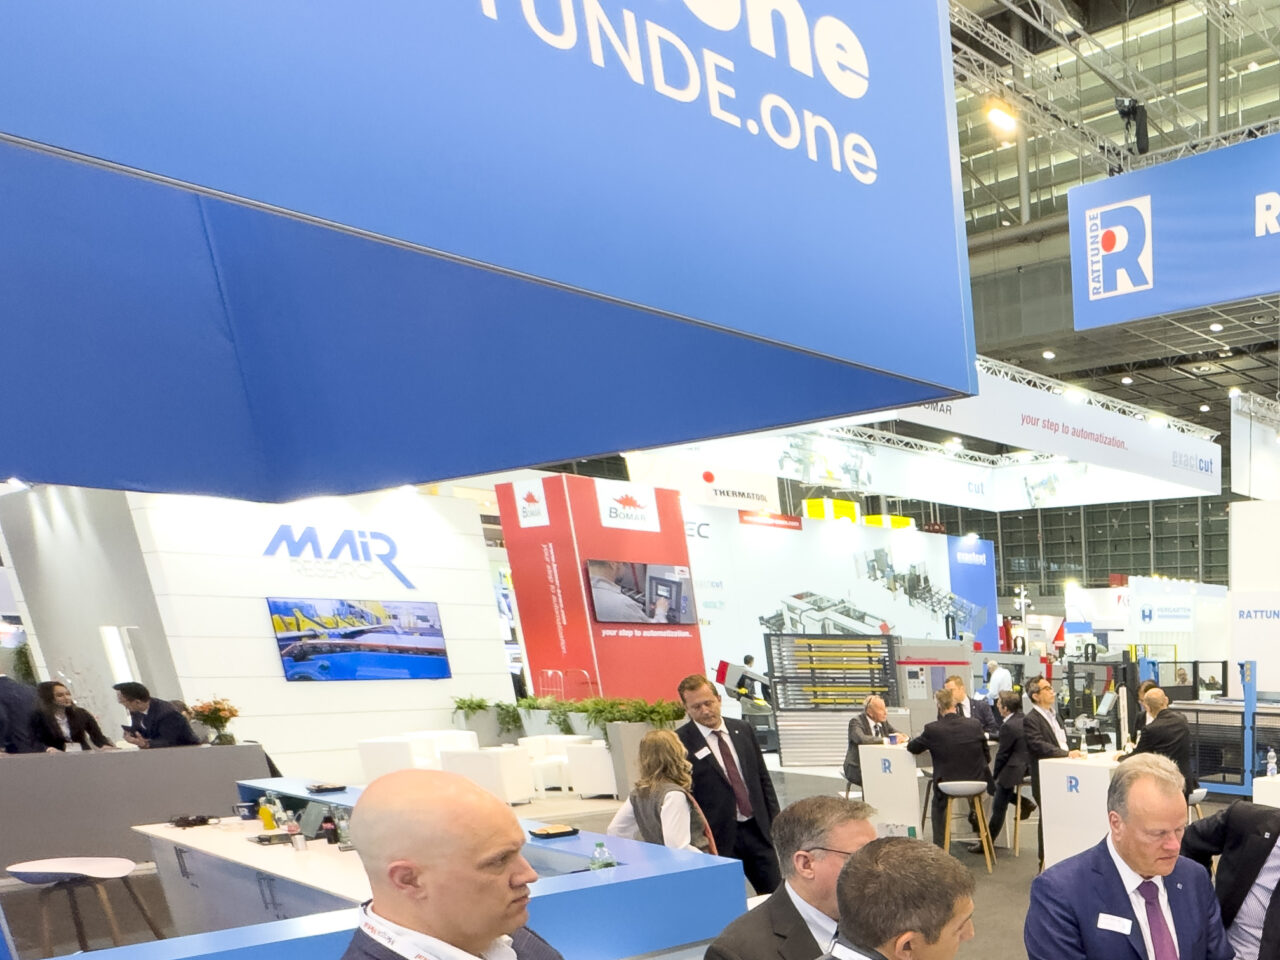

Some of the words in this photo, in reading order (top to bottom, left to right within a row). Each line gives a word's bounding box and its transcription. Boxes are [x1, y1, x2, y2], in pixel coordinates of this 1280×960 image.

[480, 0, 878, 185] UNDE.one
[1089, 211, 1102, 296] RATTUNDE
[1020, 412, 1040, 427] your
[1042, 417, 1060, 436] step
[1061, 421, 1070, 435] to
[712, 487, 768, 503] THERMATOOL
[601, 628, 618, 638] your
[618, 628, 634, 638] step
[634, 629, 642, 637] to
